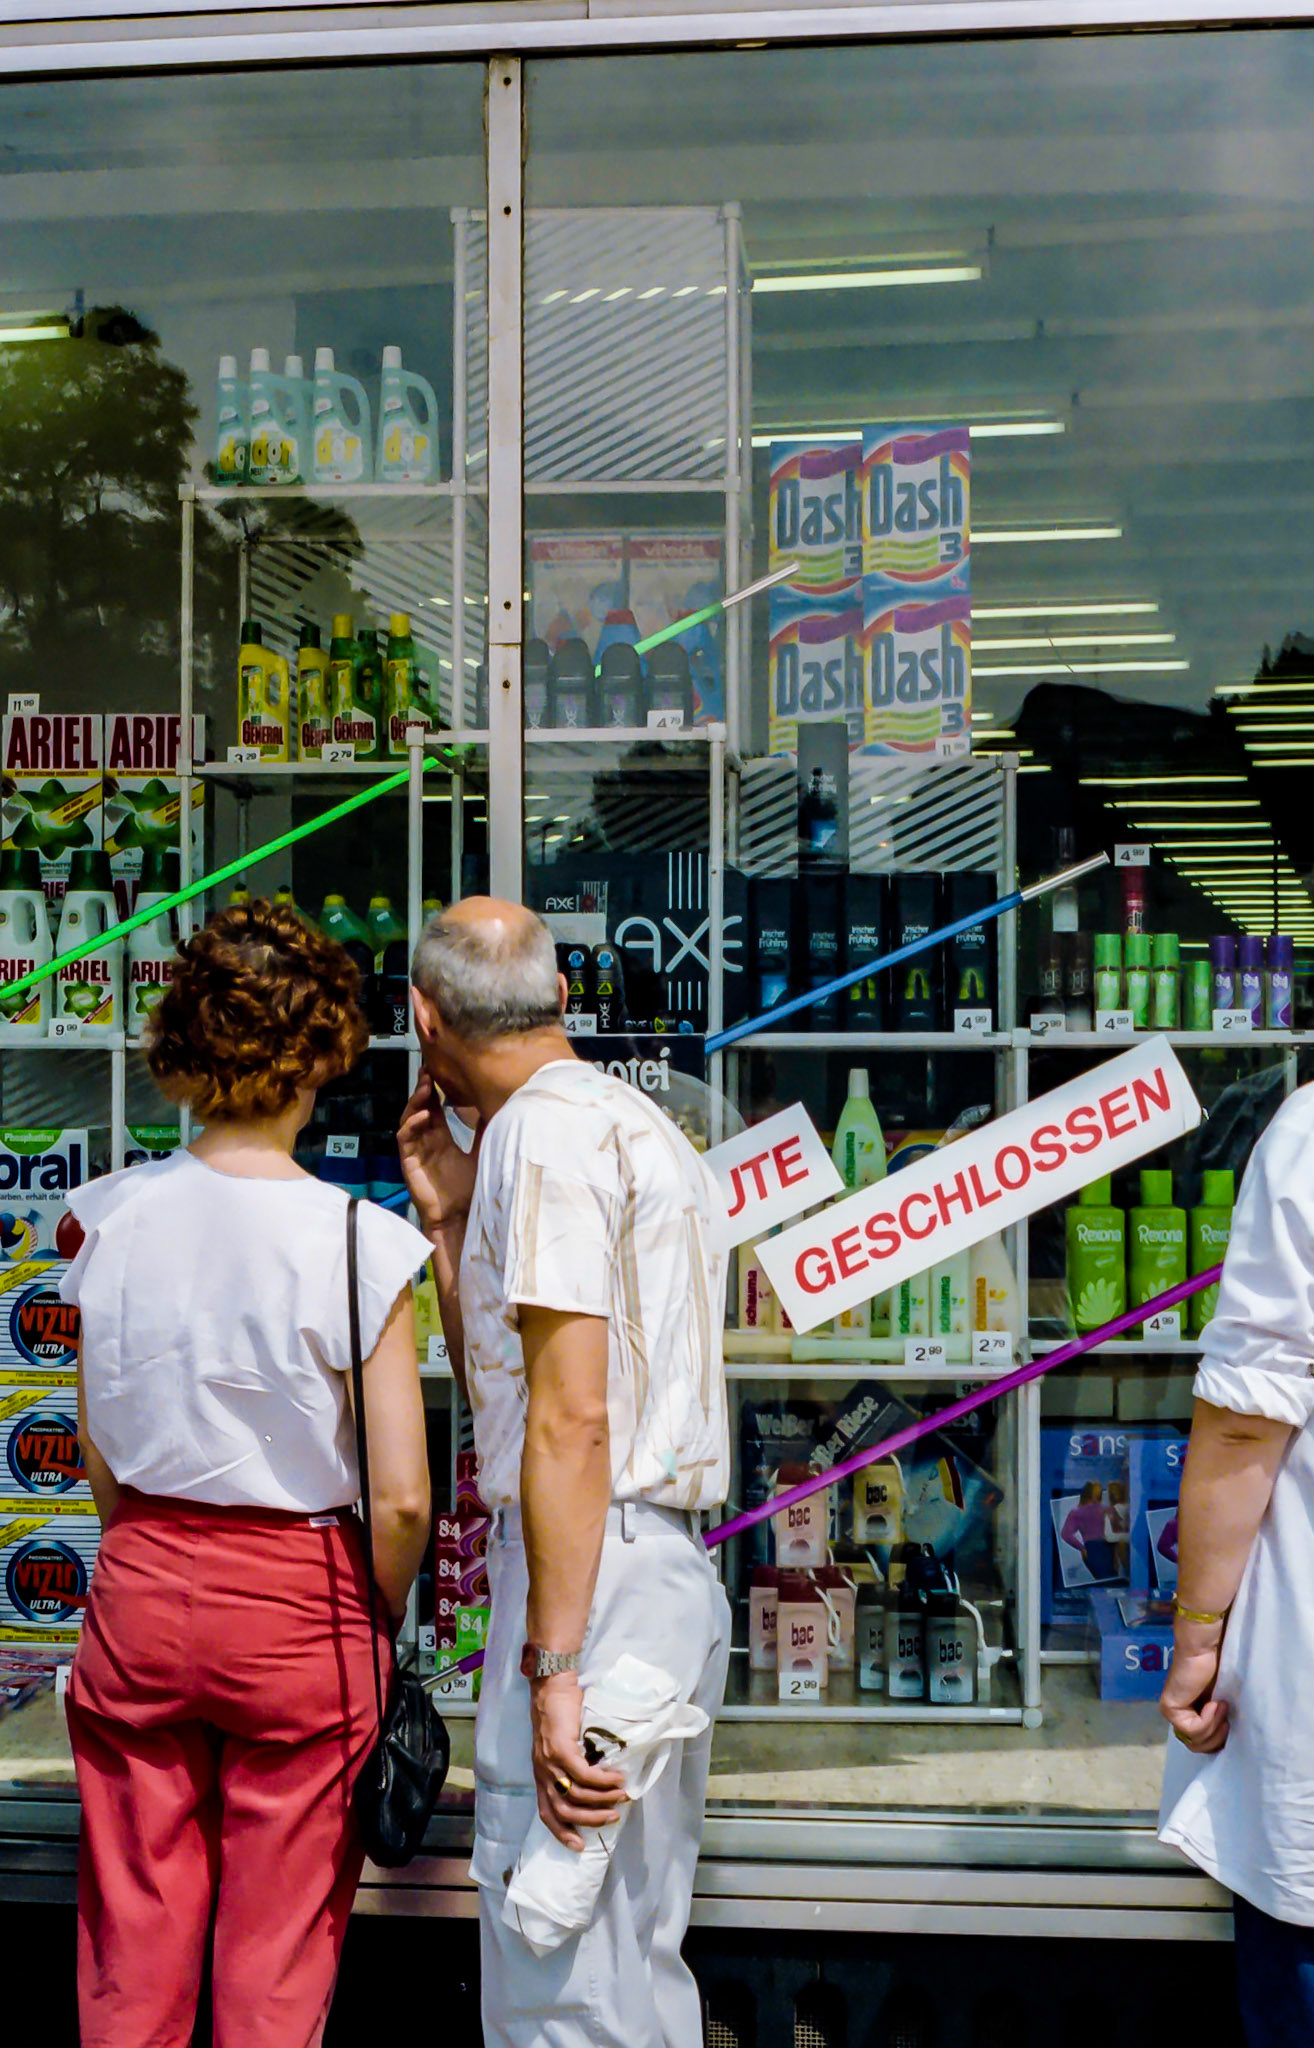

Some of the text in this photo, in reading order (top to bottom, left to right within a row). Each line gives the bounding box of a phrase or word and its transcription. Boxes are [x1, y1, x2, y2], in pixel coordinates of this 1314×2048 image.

[869, 454, 962, 536] Dash
[871, 622, 964, 709] Dash
[243, 720, 284, 745] GENERAL
[334, 716, 376, 741] GENERAL
[7, 716, 98, 769] ARIEL
[109, 716, 194, 769] ARIE
[546, 897, 574, 911] AXE
[614, 916, 744, 974] AXE
[59, 960, 111, 982] ARIEL
[131, 961, 173, 982] ARIE
[794, 1068, 1171, 1294] GESCHLOSSEN
[1076, 1224, 1121, 1244] Rexona
[1137, 1224, 1183, 1244] Rexona
[33, 1343, 65, 1354] ULTRA
[1069, 1433, 1127, 1457] sans
[30, 1471, 62, 1482] ULTRA
[866, 1481, 888, 1505] bac
[788, 1505, 811, 1528] bac
[29, 1599, 62, 1610] ULTRA
[762, 1606, 777, 1631] ba
[791, 1622, 814, 1646] bac
[939, 1637, 963, 1663] bac
